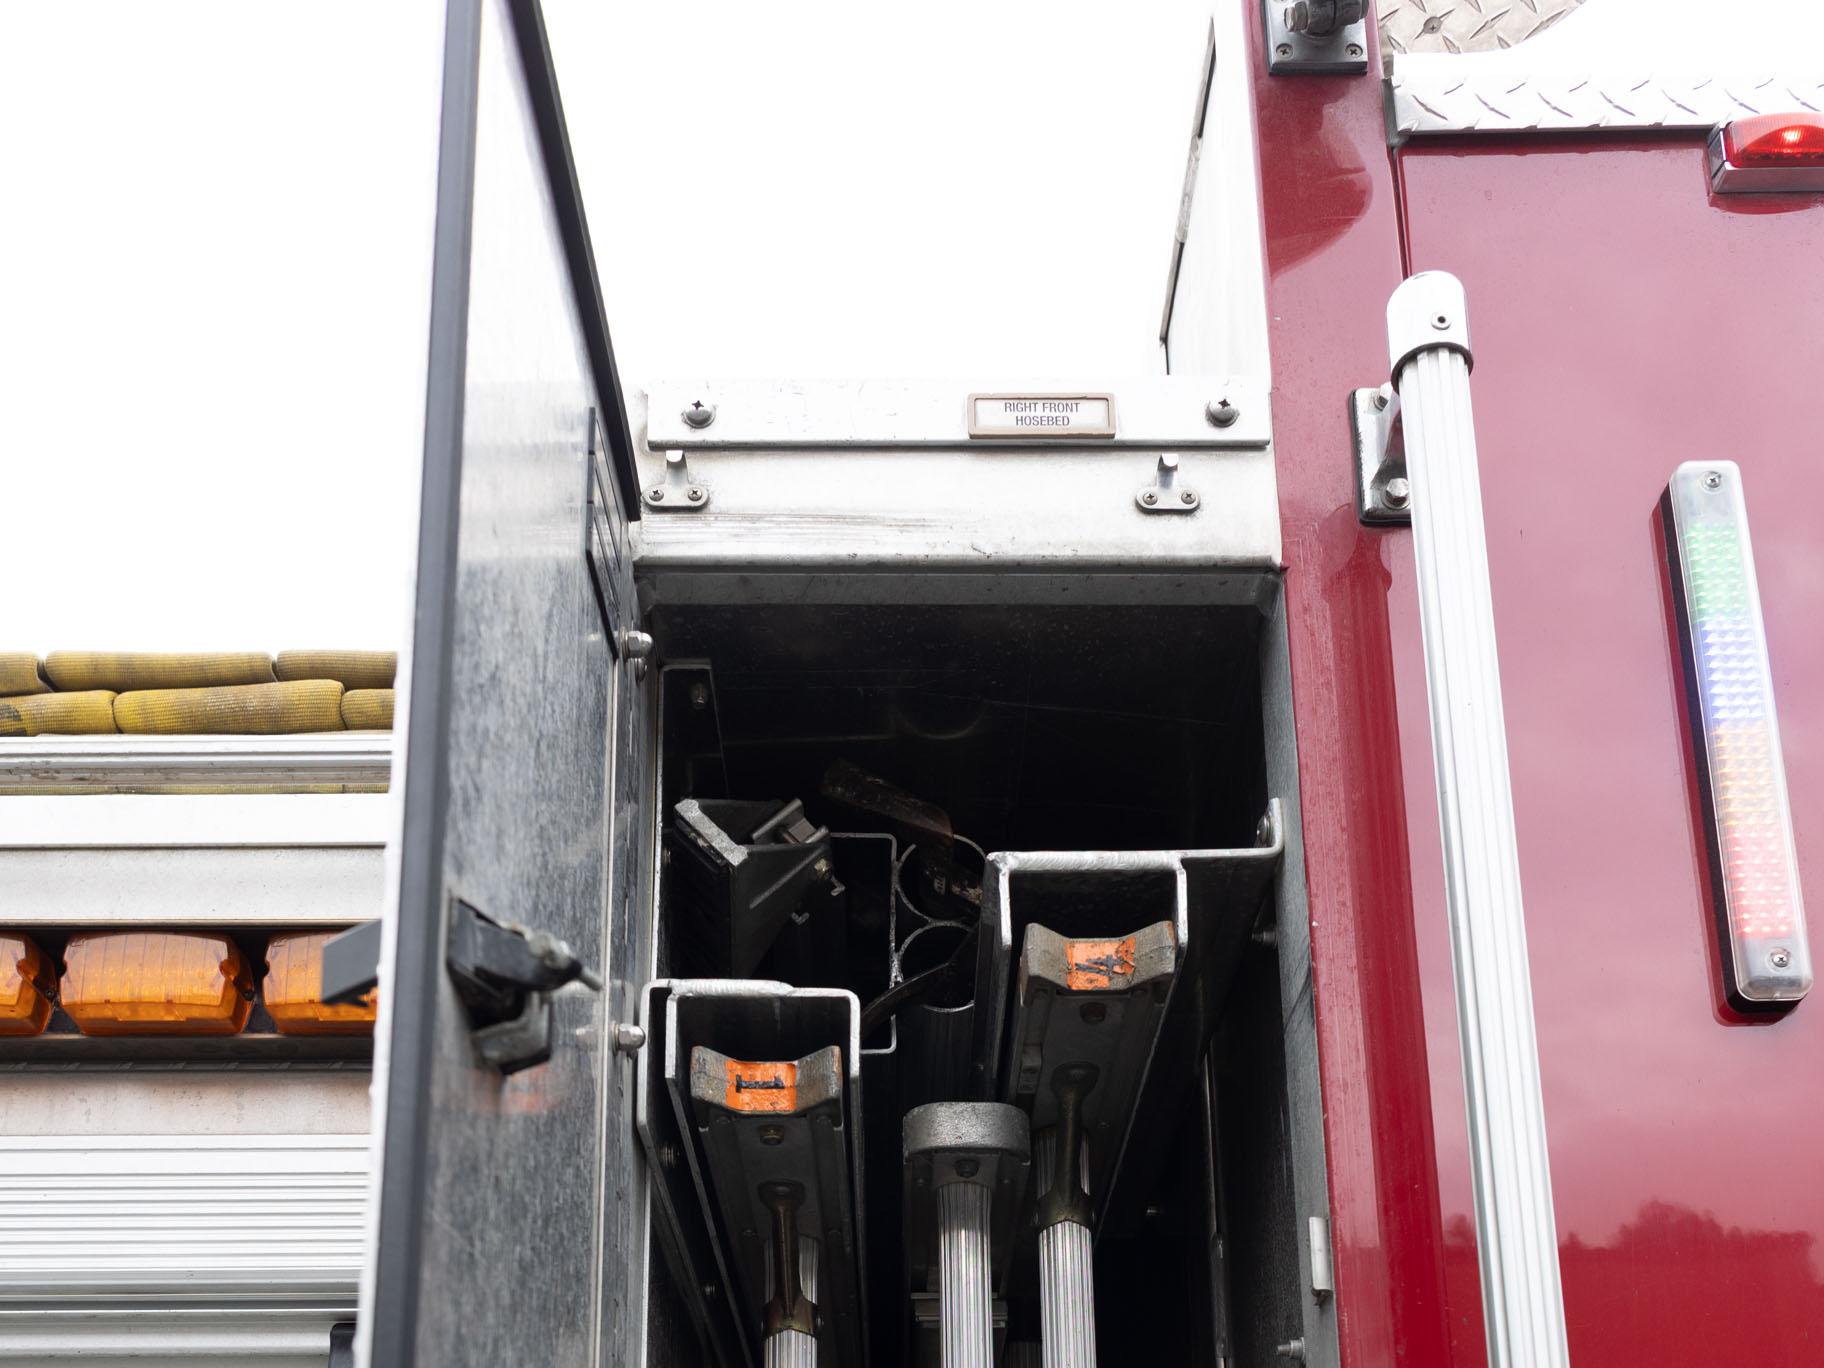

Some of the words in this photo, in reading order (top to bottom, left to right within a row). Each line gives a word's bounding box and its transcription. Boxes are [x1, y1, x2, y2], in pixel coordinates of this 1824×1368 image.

[1004, 402, 1038, 413] RIGHT
[1042, 402, 1081, 413] FRONT
[1015, 415, 1070, 426] HOSEBED
